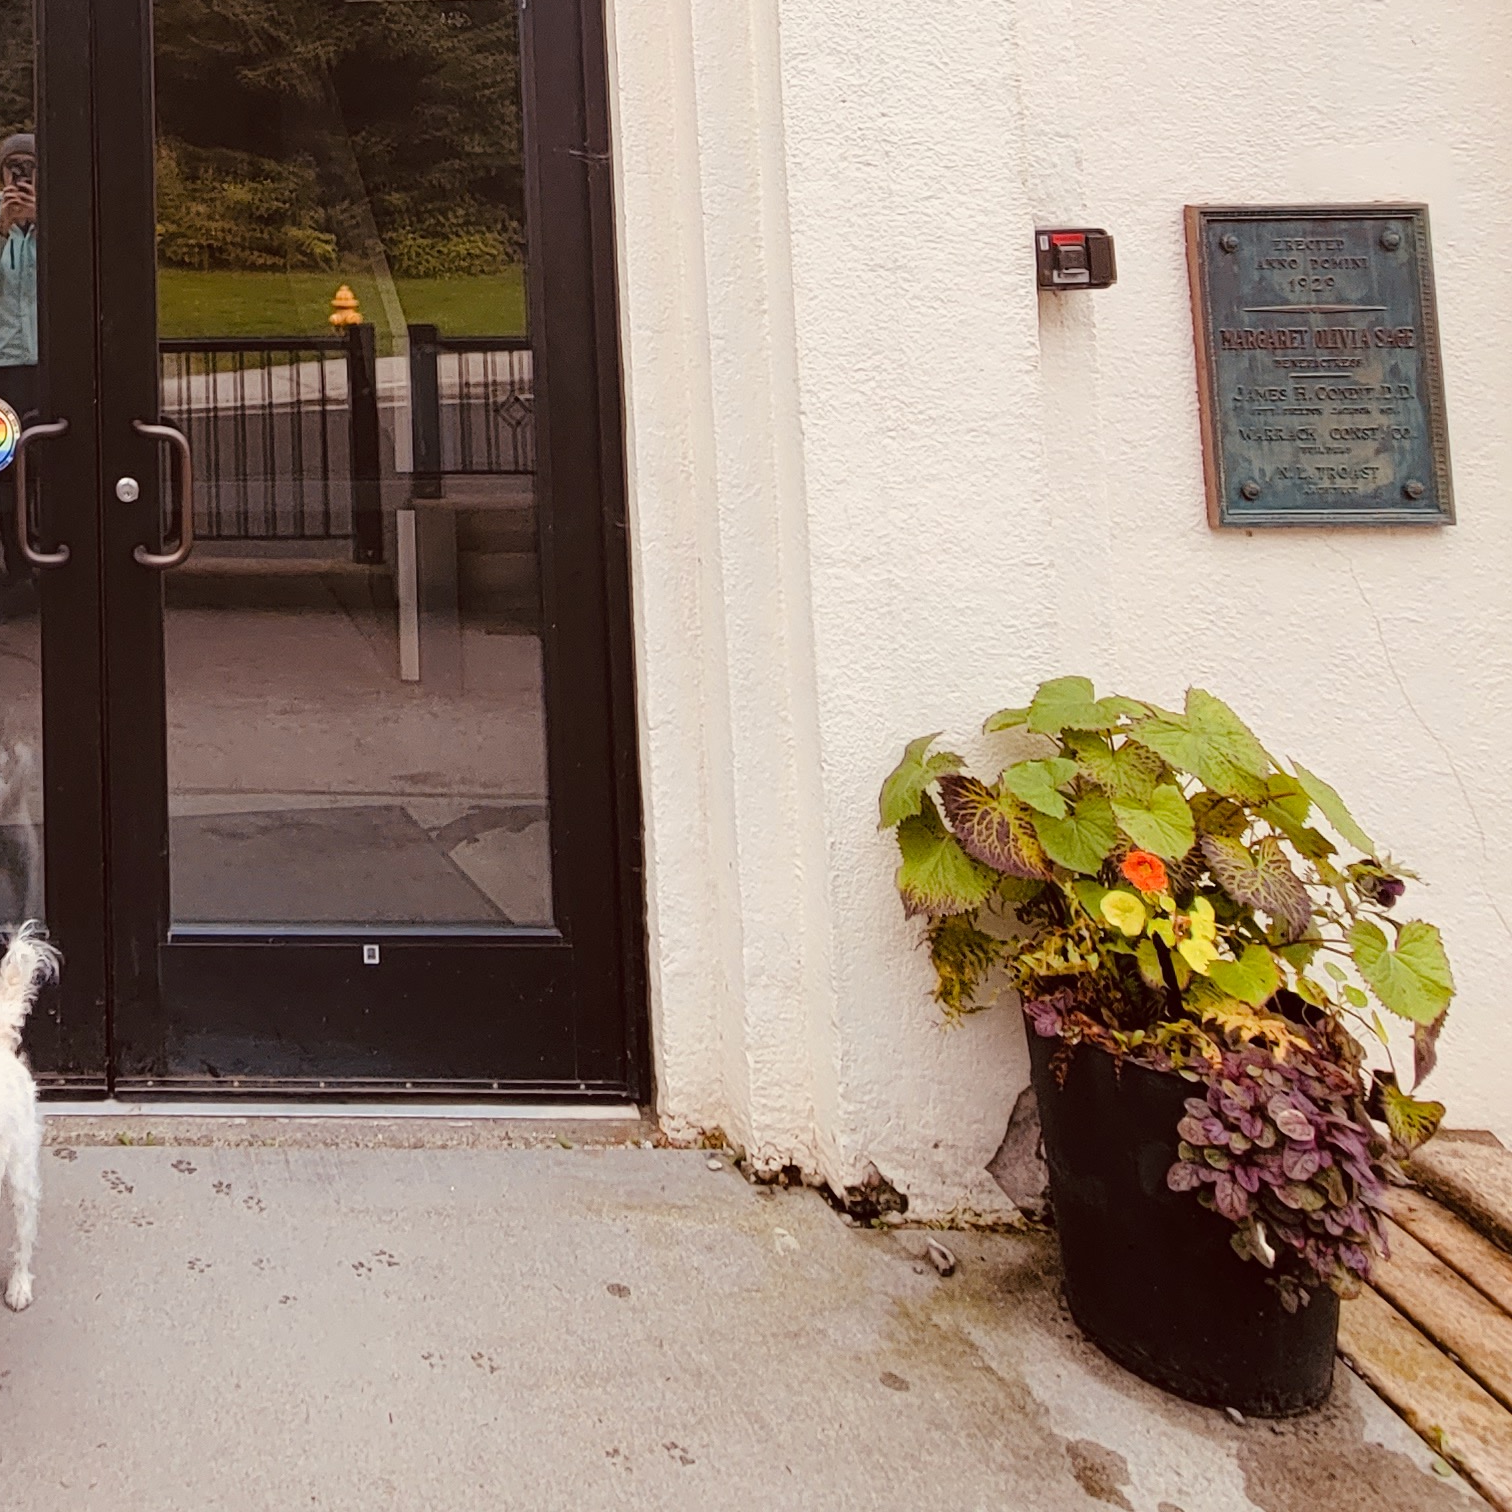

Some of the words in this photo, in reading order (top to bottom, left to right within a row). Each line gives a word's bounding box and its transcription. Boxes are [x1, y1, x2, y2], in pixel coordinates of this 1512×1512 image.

[1255, 257, 1300, 270] ANNO
[1310, 256, 1369, 270] DOMINI
[1287, 275, 1336, 292] 1929
[1219, 327, 1309, 350] MARGARET
[1313, 327, 1371, 350] OLIVIA
[1374, 326, 1415, 349] SAGE
[1232, 384, 1288, 402] JAMES
